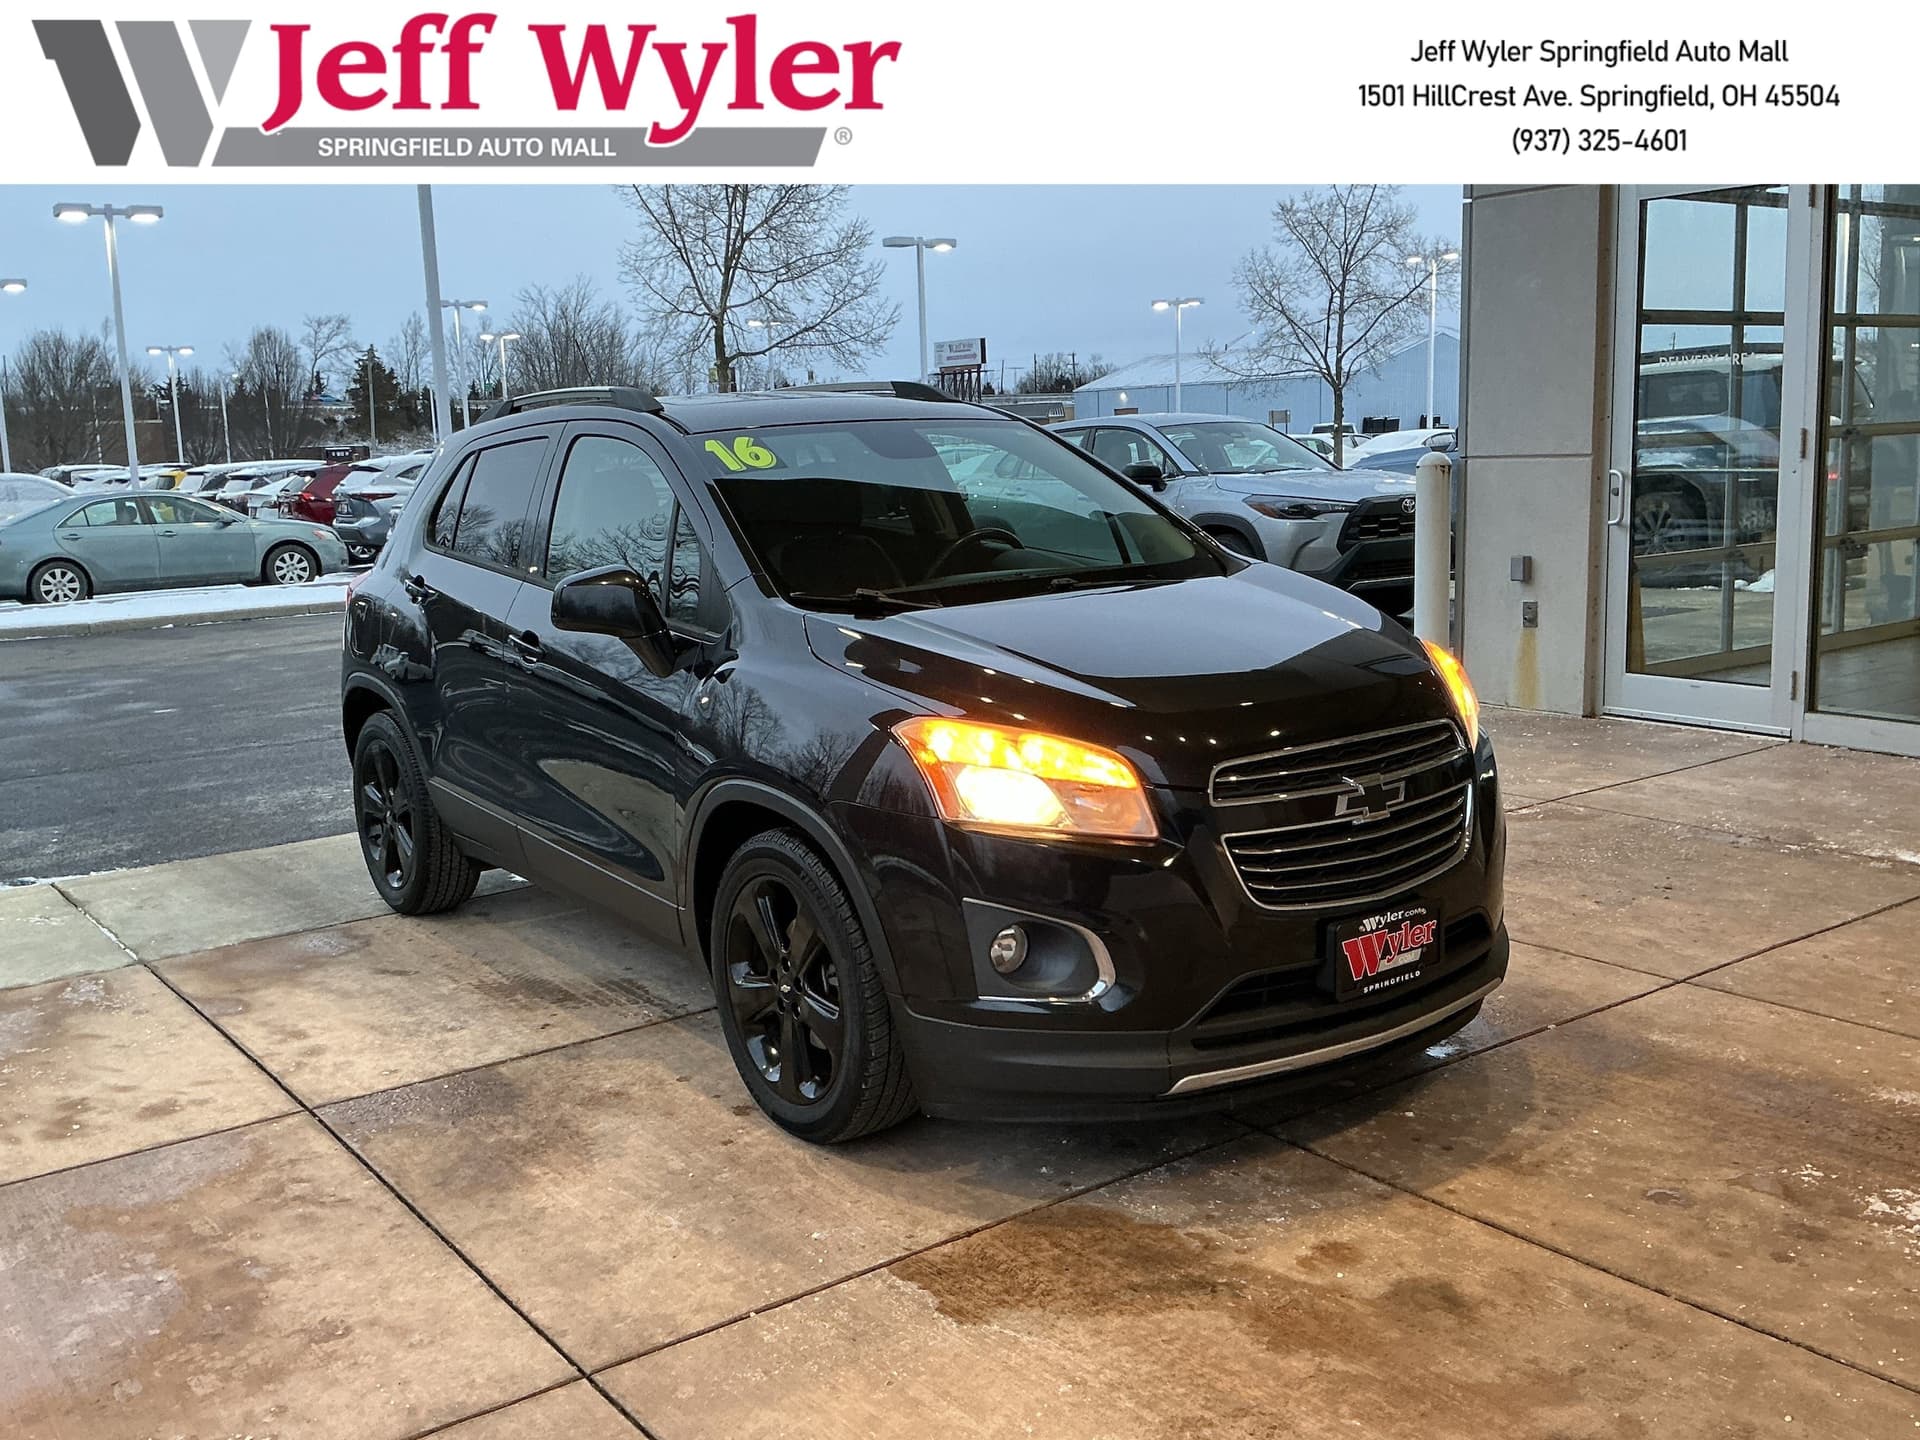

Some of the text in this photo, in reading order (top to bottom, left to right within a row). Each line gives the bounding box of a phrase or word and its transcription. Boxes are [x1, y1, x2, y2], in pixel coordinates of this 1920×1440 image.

[1721, 352, 1755, 365] ARE
[704, 436, 777, 471] 16
[1341, 919, 1437, 981] Wyler
[1362, 970, 1421, 994] SPRINGFIELD
